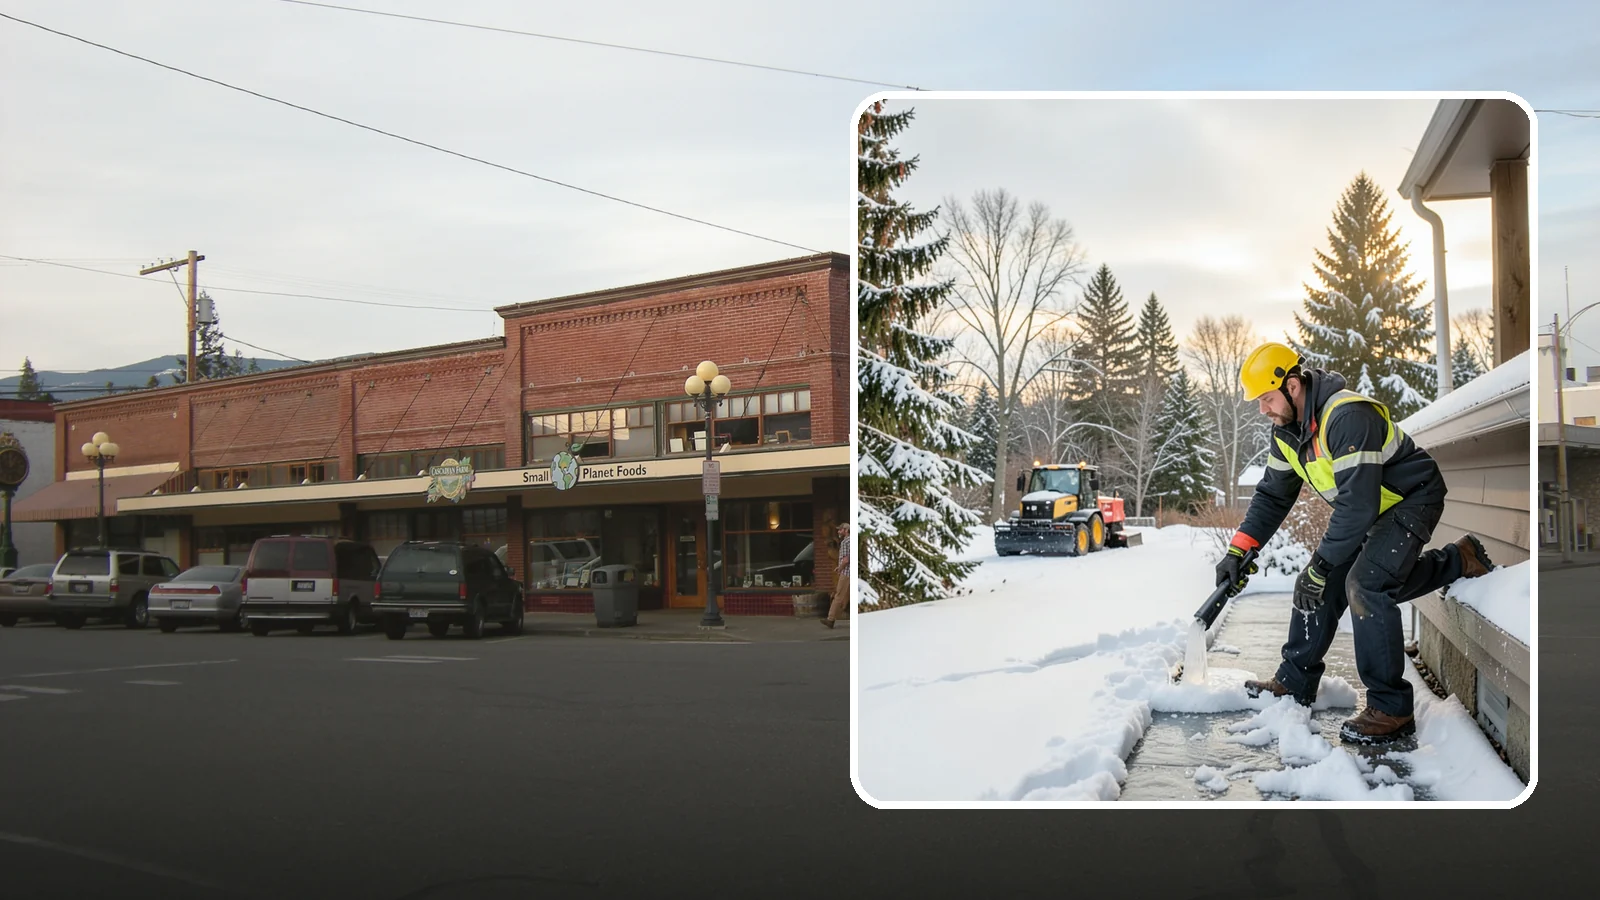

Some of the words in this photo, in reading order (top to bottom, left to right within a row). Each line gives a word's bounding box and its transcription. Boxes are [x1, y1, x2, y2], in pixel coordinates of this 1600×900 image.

[523, 470, 549, 483] Small
[582, 467, 614, 479] Planet
[617, 464, 647, 477] Foods
